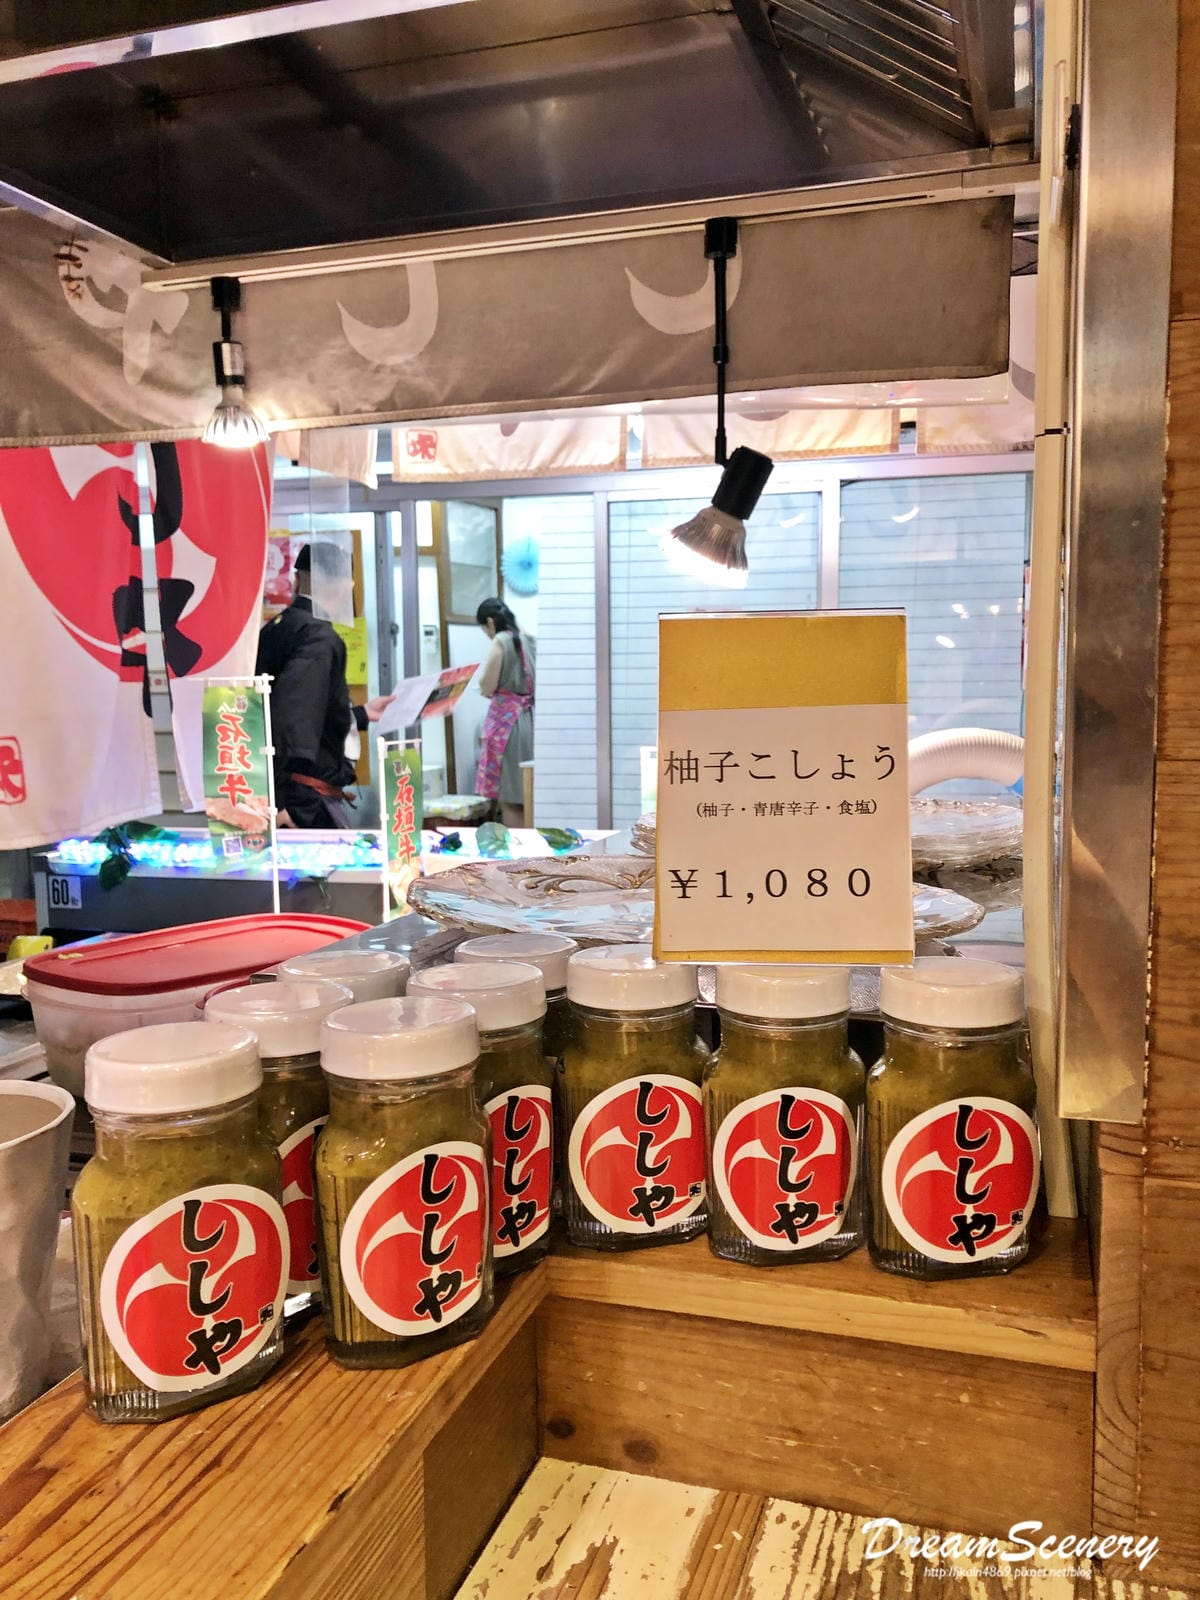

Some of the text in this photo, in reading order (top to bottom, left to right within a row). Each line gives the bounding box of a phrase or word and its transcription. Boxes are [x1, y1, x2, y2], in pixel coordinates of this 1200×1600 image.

[392, 774, 416, 864] 石垣牛
[663, 745, 896, 785] 柚子こしょう
[497, 1095, 537, 1248] ししや
[628, 1081, 676, 1226] ししや
[769, 1094, 819, 1244] ししや
[947, 1104, 998, 1257] ししや
[183, 1199, 243, 1376] ししや
[414, 1154, 463, 1323] ししや
